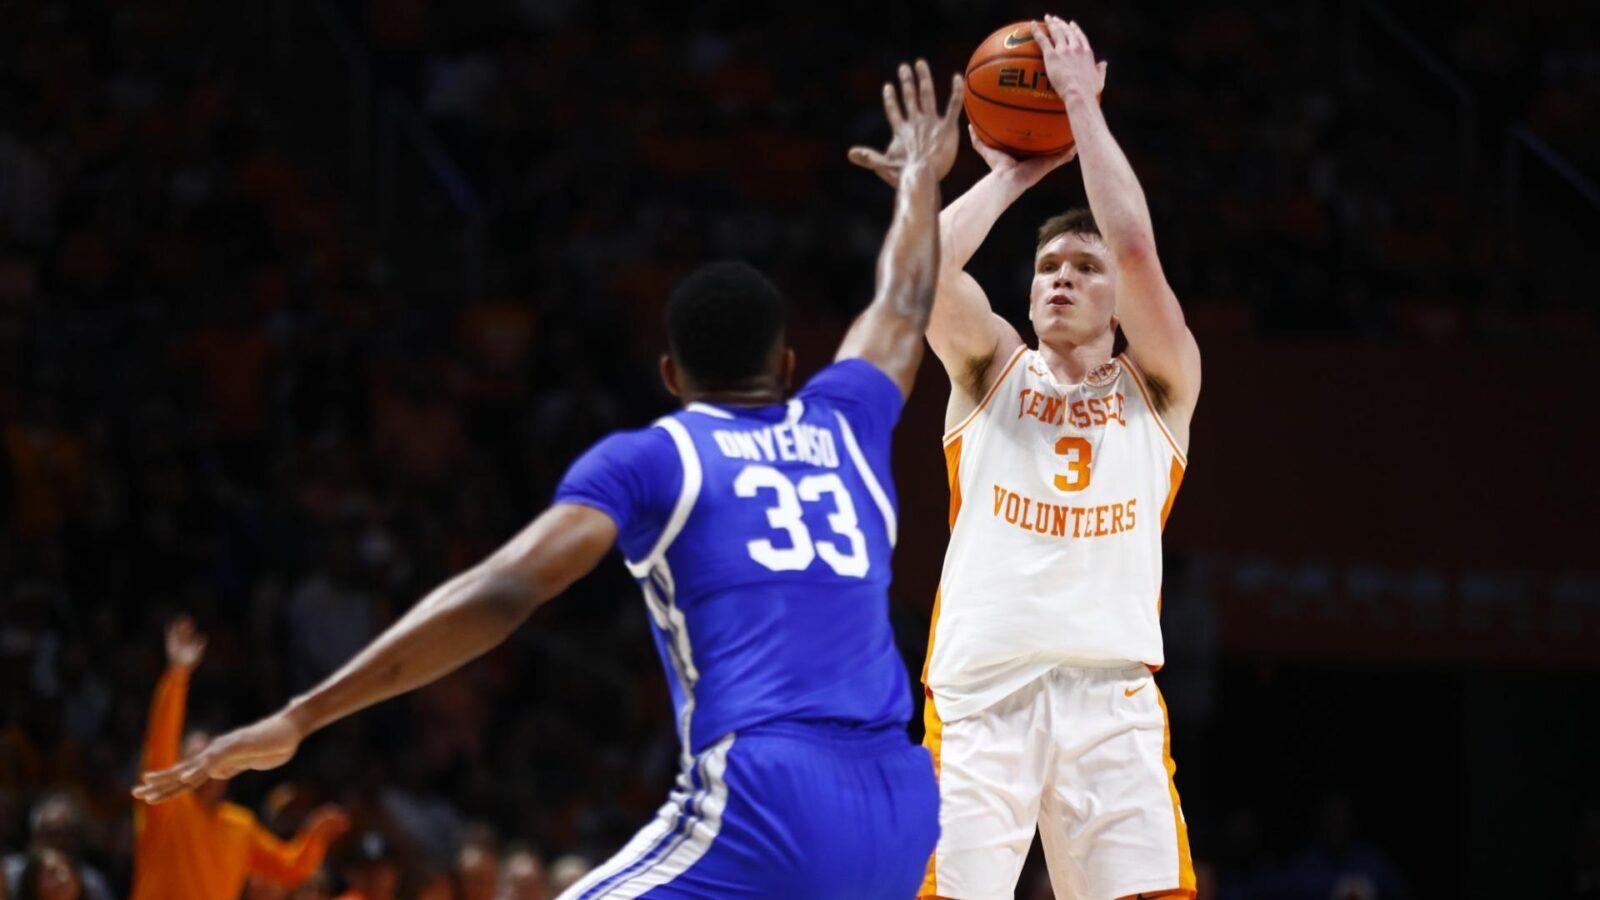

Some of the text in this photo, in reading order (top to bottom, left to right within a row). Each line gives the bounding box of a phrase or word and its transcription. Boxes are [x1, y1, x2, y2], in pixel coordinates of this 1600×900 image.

[998, 67, 1054, 90] ELIT
[713, 422, 839, 468] ONYENSO
[1054, 437, 1092, 492] 3
[734, 464, 870, 579] 33
[993, 484, 1137, 538] VOLUNTEERS
